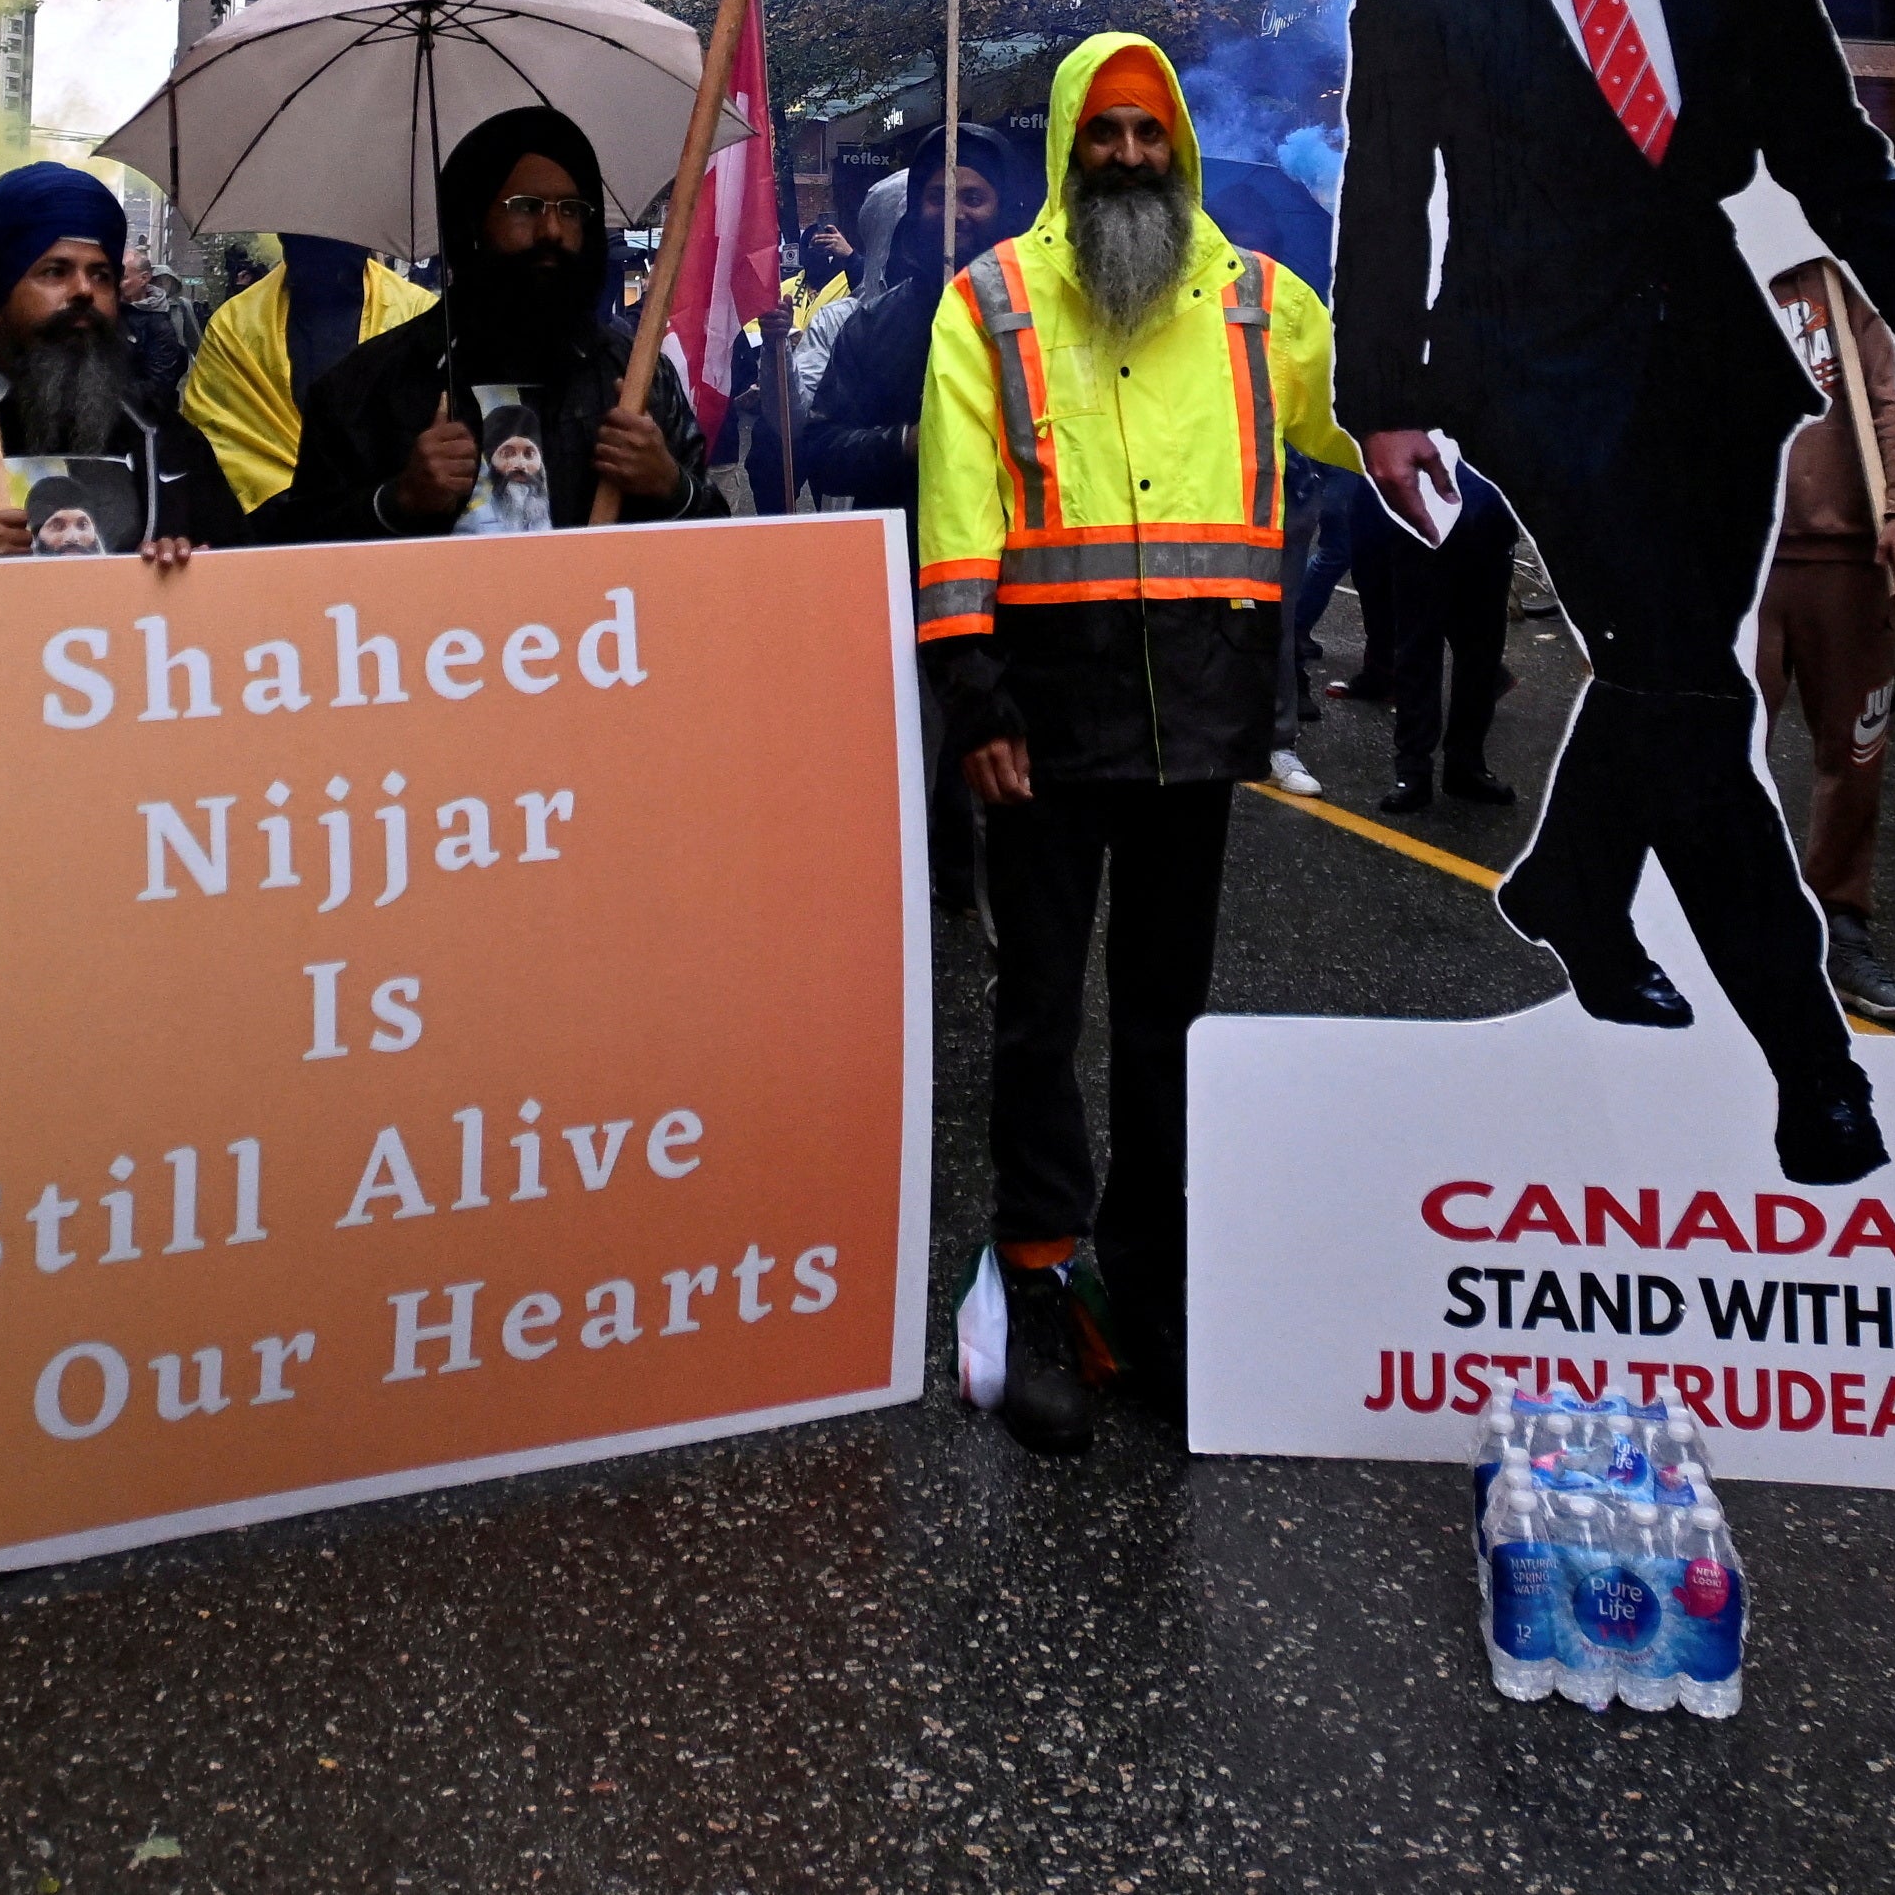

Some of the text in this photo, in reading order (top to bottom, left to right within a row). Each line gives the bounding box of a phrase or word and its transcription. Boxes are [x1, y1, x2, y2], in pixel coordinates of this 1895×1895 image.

[842, 152, 890, 166] reflex
[41, 586, 647, 730] Shaheed
[137, 766, 577, 914] Nijjar
[305, 960, 424, 1062] Is
[335, 1104, 706, 1231] Alive
[32, 1322, 316, 1441] Our
[380, 1235, 841, 1385] Hearts
[1443, 1266, 1894, 1349] STAND WITH
[1591, 1577, 1644, 1603] Pure
[1598, 1598, 1636, 1621] Life
